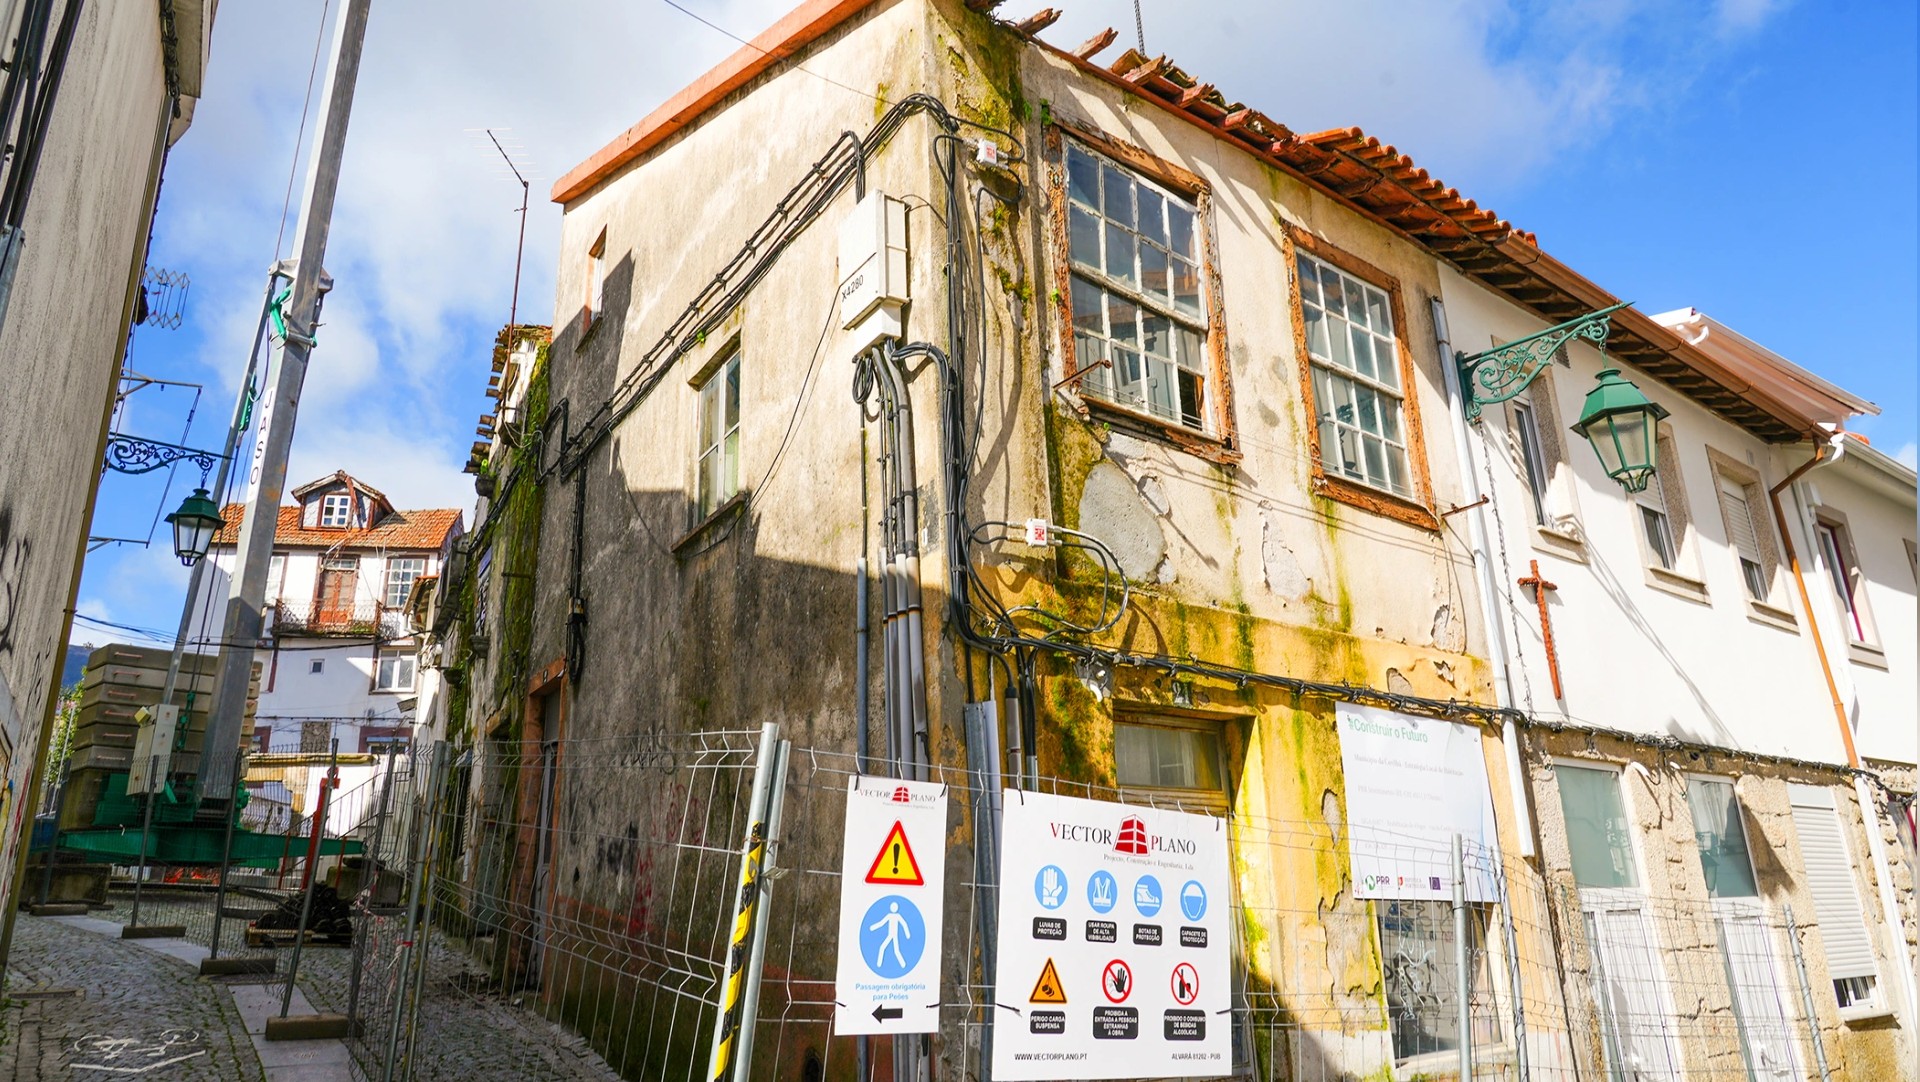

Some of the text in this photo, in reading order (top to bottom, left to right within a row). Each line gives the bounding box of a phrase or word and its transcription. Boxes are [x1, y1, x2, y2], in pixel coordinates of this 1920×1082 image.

[841, 274, 864, 303] X4280
[250, 389, 273, 486] JASO
[1347, 718, 1429, 744] #Construir o Futuro
[859, 788, 936, 803] VECTOR PLANO
[1050, 822, 1196, 856] VECTOR PLANO
[1375, 875, 1391, 885] PRR
[1039, 921, 1053, 929] LUVAS
[855, 983, 926, 991] Passagem obrigatória
[1014, 1053, 1088, 1061] WWW.VECTORPLANO.PT
